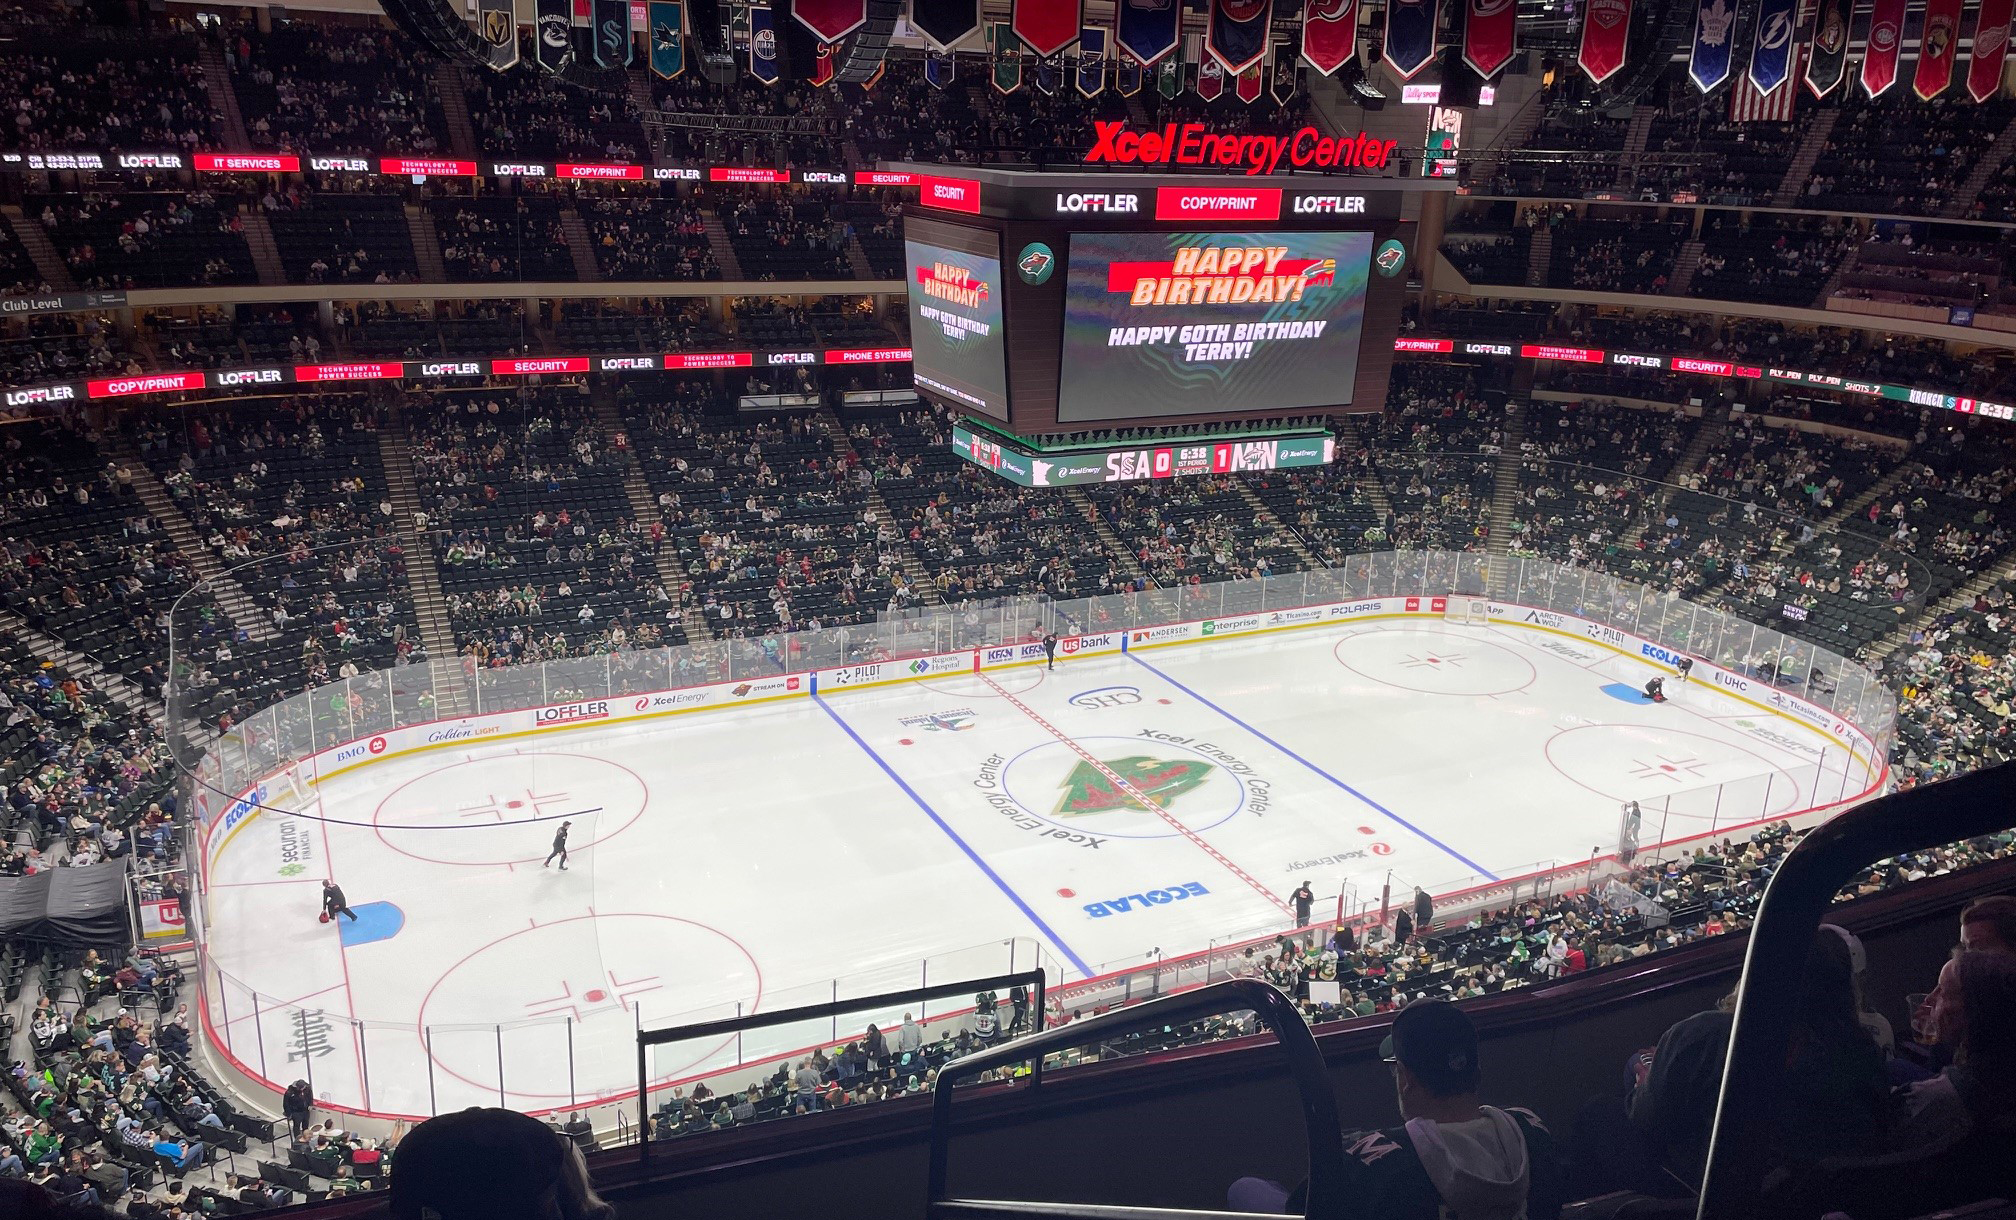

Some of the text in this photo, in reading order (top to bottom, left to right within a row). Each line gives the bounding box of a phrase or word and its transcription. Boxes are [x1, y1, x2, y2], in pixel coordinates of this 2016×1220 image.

[1084, 121, 1398, 175] Xcel Energy Center
[119, 155, 182, 168] LOFFLER
[214, 159, 281, 169] IT SERVICES
[311, 158, 369, 171] LOFFLER
[494, 164, 545, 176] LOFFLER
[572, 166, 627, 177] COPY/PRINT
[653, 168, 700, 180] LOFFLER
[803, 171, 846, 183] LOFFLER
[872, 174, 910, 183] SECURITY
[933, 183, 966, 202] SECURITY
[1056, 192, 1139, 213] LOFFLER
[1179, 195, 1258, 211] COPY/PRINT
[1293, 195, 1366, 213] LOFFLER
[1172, 246, 1289, 275] HAPPY
[934, 261, 970, 287] HAPPY
[924, 277, 979, 309] BIRTHDAY!
[1130, 275, 1309, 306] BIRTHDAY!
[2, 298, 63, 312] Club Level
[920, 304, 990, 337] HAPPY 60TH BIRTHDAY
[942, 323, 965, 341] TERRY!
[1107, 320, 1327, 346] HAPPY 60TH BIRTHDAY
[1184, 341, 1254, 362] TERRY!
[1394, 340, 1440, 351] OPY/PRINT
[1466, 343, 1511, 355] LOFFLER
[768, 352, 815, 365] LOFFLER
[843, 350, 913, 361] PHONE SYSTEMS
[1613, 354, 1661, 368] LOFFLER
[318, 365, 371, 373] TECHNOLOGY
[422, 363, 480, 376] LOFFLER
[514, 361, 569, 372] SECURITY
[601, 357, 654, 370] LOFFLER
[1678, 360, 1727, 374] SECURITY
[218, 369, 282, 386] LOFFLER
[108, 377, 186, 394] COPY/PRINT
[1844, 382, 1880, 394] SHOTS 7
[7, 386, 74, 406] LOFFLER
[1909, 389, 1944, 408] KRAKEN
[1960, 399, 1970, 411] 0
[1979, 402, 2014, 419] 6:38
[1180, 447, 1207, 460] 6:38
[1217, 448, 1227, 468] 1
[1231, 440, 1278, 472] MIN
[1105, 450, 1151, 482] SEA
[1156, 452, 1170, 472] 0
[1187, 459, 1207, 467] PERIOD
[1331, 603, 1382, 615] POLARIS
[1206, 618, 1257, 631] enterprise
[1539, 612, 1565, 623] ARCTIC
[1542, 619, 1562, 628] WOLF
[1150, 627, 1188, 637] ANDERSEN
[1603, 628, 1625, 643] PILOT
[1021, 645, 1047, 656] KFAN
[1064, 635, 1111, 651] us bank
[932, 656, 959, 665] Regions
[988, 648, 1013, 660] KFAN
[1642, 643, 1680, 666] ECOLA
[855, 665, 881, 678] PILOT
[932, 661, 960, 671] Hospital
[753, 684, 776, 692] STREAM
[1724, 676, 1748, 691] UHC
[1077, 693, 1142, 710] CHS
[536, 702, 608, 722] LOFFLER
[428, 726, 500, 742] Golden LIGHT
[337, 746, 365, 762] BMO
[1136, 728, 1272, 818] Xcel Energy Center
[225, 785, 268, 831] ECOLAB
[973, 753, 1109, 850] Xcel Energy Center
[281, 821, 299, 863] securian
[1082, 881, 1212, 919] ECOLAB
